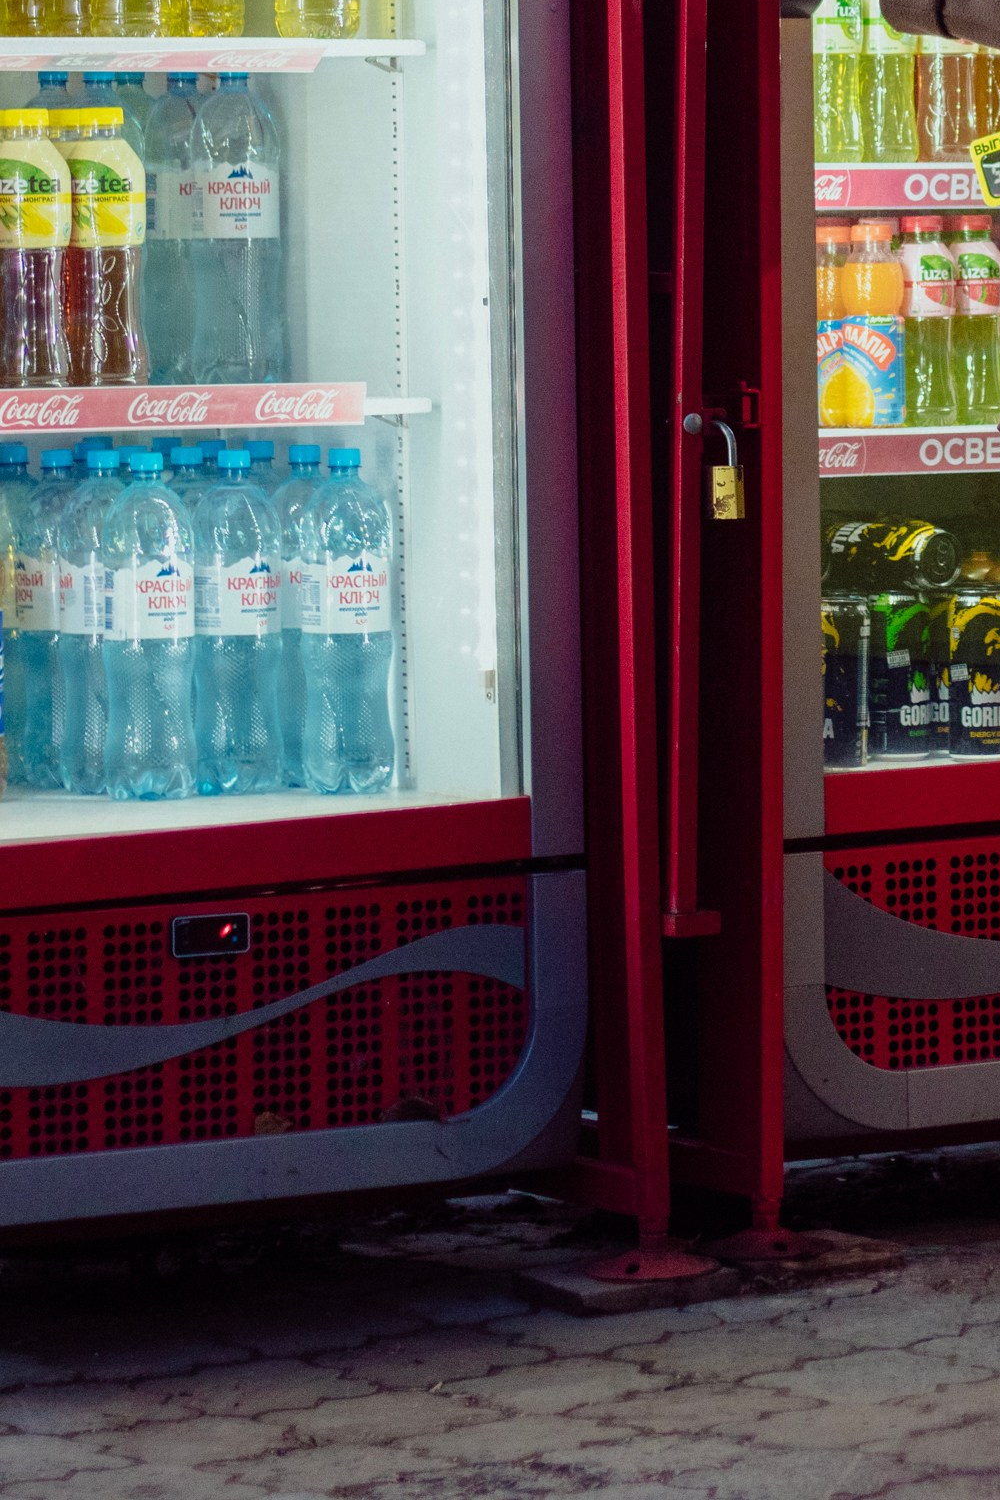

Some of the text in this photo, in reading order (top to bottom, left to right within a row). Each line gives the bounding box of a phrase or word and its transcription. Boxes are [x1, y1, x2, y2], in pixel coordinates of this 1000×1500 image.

[208, 178, 271, 195] КРАСНЫЙ
[220, 196, 261, 211] КЛЮЧ
[127, 391, 214, 424] Coca-Cola
[255, 388, 340, 421] Coca-Cola
[227, 571, 281, 590] КРАСНЫЙ
[326, 570, 388, 589] КРАСНЫЙ
[241, 591, 277, 607] КЛЮЧ
